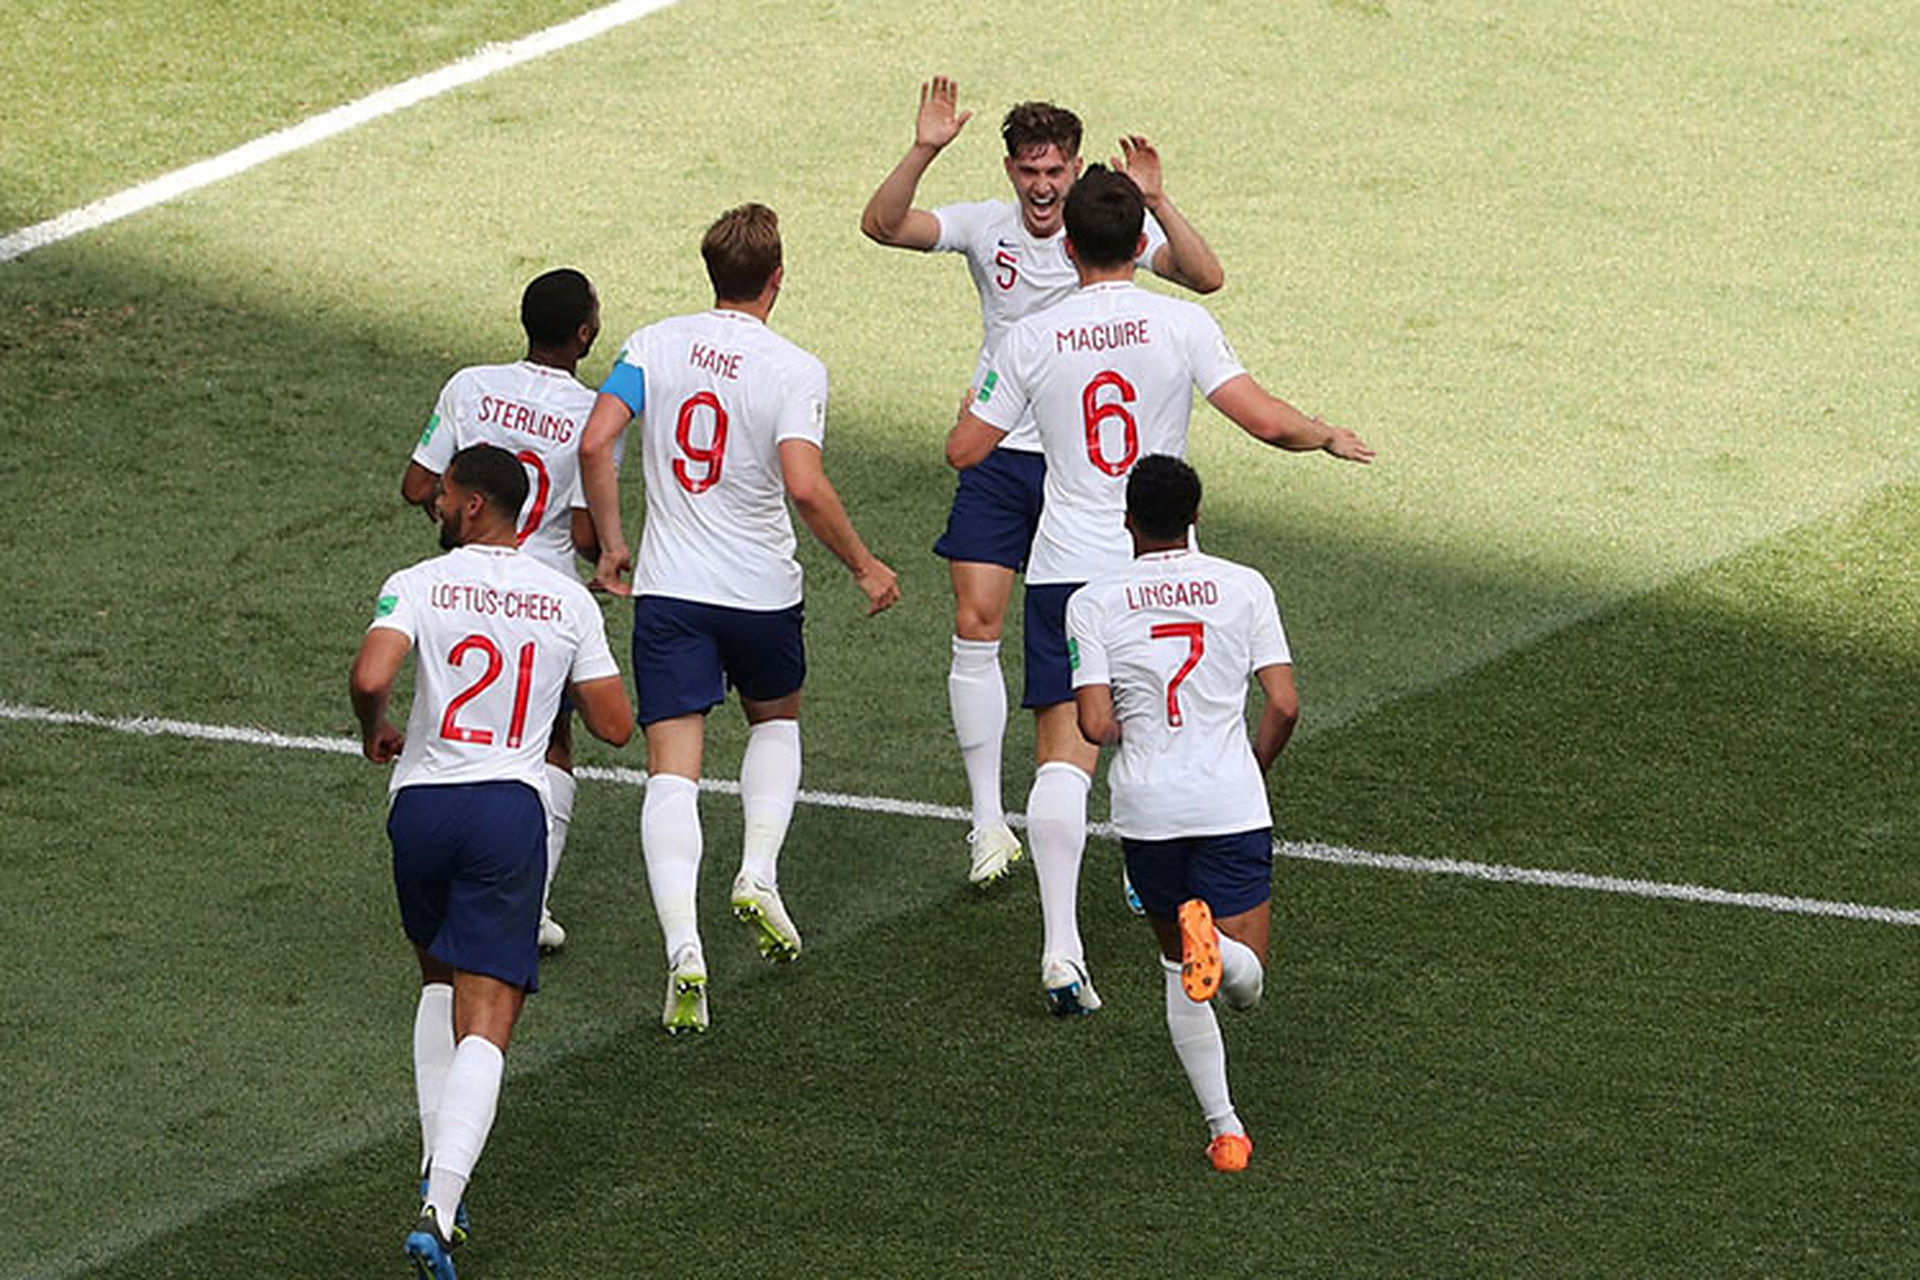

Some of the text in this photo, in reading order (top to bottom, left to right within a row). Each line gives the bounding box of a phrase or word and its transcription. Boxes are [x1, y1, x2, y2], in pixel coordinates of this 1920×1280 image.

[994, 249, 1019, 291] 5
[1056, 318, 1151, 353] MAGUIRE
[690, 343, 743, 380] KANE
[478, 395, 574, 444] STERLING
[1082, 370, 1139, 477] 6
[672, 390, 729, 495] 9
[431, 584, 563, 622] LOFTUS-CHEEK
[1126, 580, 1219, 611] LINGARD
[440, 634, 536, 749] 21
[1150, 621, 1205, 728] 7
